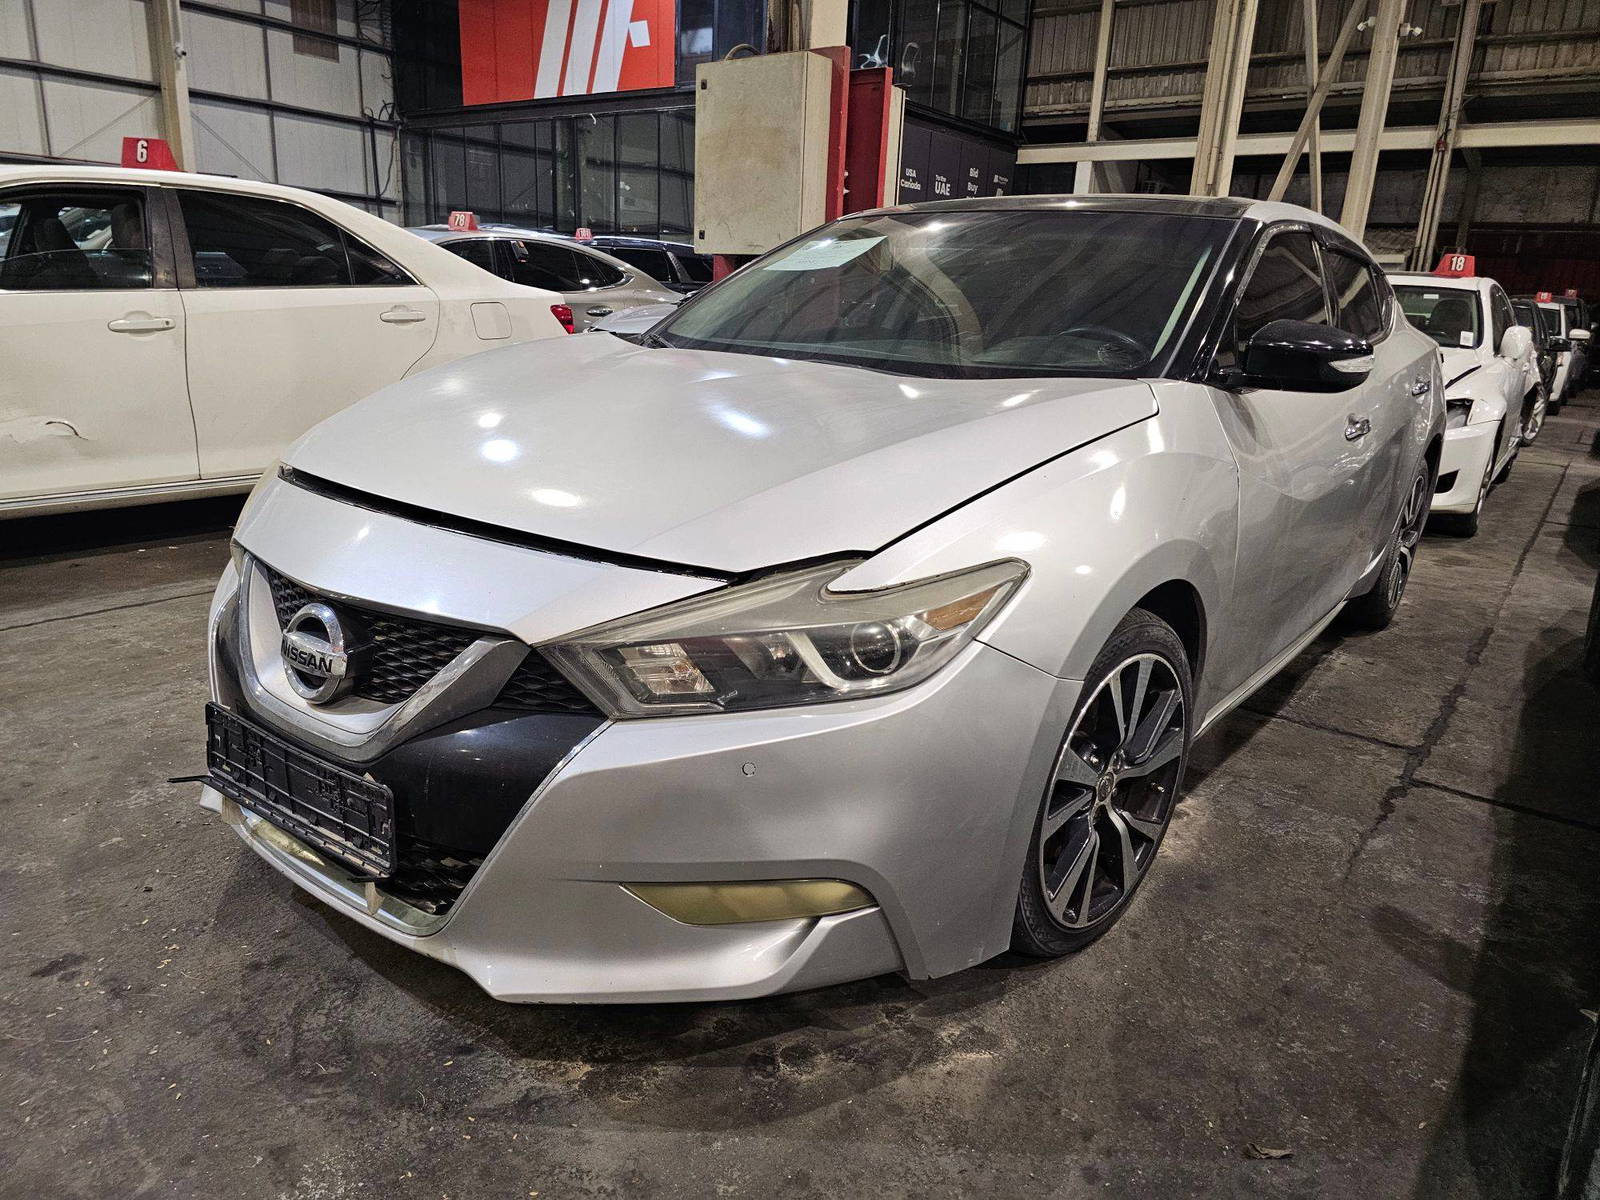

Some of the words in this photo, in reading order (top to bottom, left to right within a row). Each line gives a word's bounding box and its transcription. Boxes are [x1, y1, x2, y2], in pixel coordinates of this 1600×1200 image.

[137, 140, 148, 163] 6
[905, 168, 917, 178] USA
[969, 167, 979, 178] Bid
[900, 178, 921, 190] Canada
[934, 181, 951, 196] UAE
[967, 182, 979, 195] Buy
[454, 214, 465, 227] 78
[1451, 256, 1465, 271] 18
[281, 634, 332, 672] NISSAN
